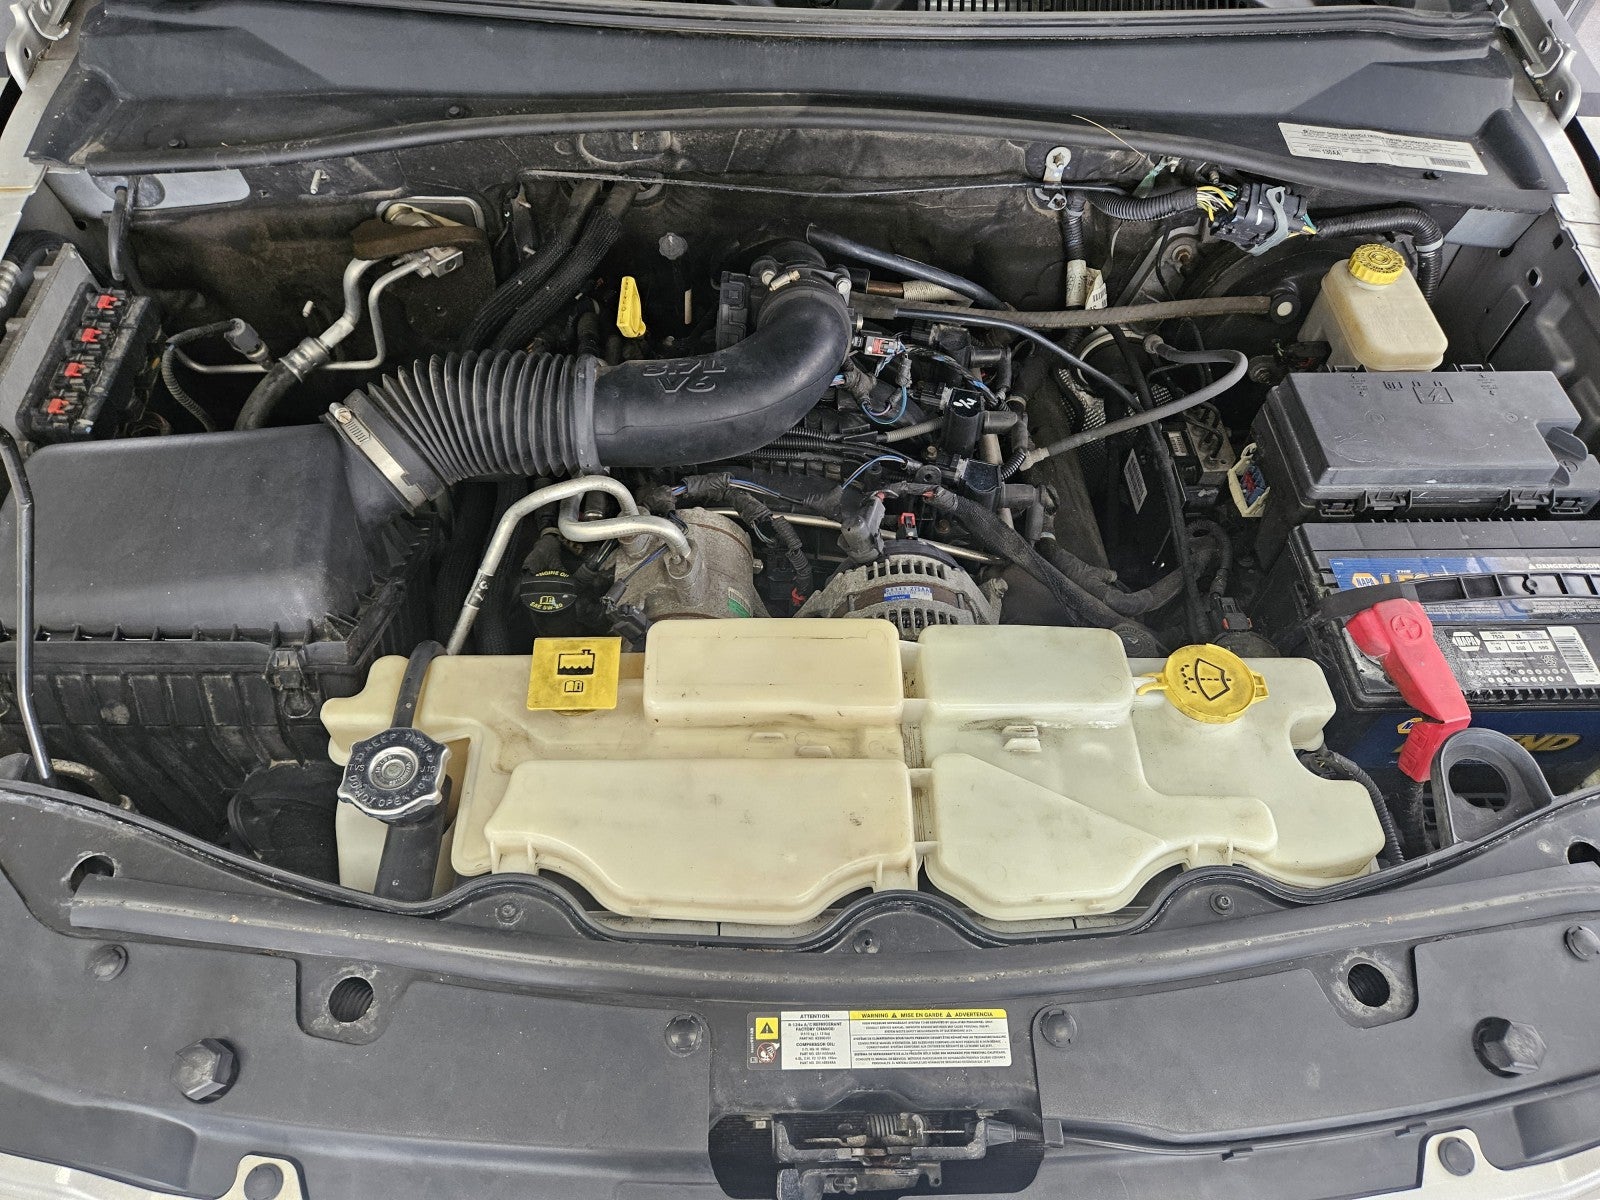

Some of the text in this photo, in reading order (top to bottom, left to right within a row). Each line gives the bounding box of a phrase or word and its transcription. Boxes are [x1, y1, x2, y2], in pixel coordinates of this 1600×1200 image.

[643, 359, 727, 377] 3.7L
[657, 376, 716, 393] V6
[1455, 636, 1479, 647] NAPA
[364, 733, 397, 752] KEEP
[348, 763, 366, 772] TVS
[378, 795, 411, 807] OPEN
